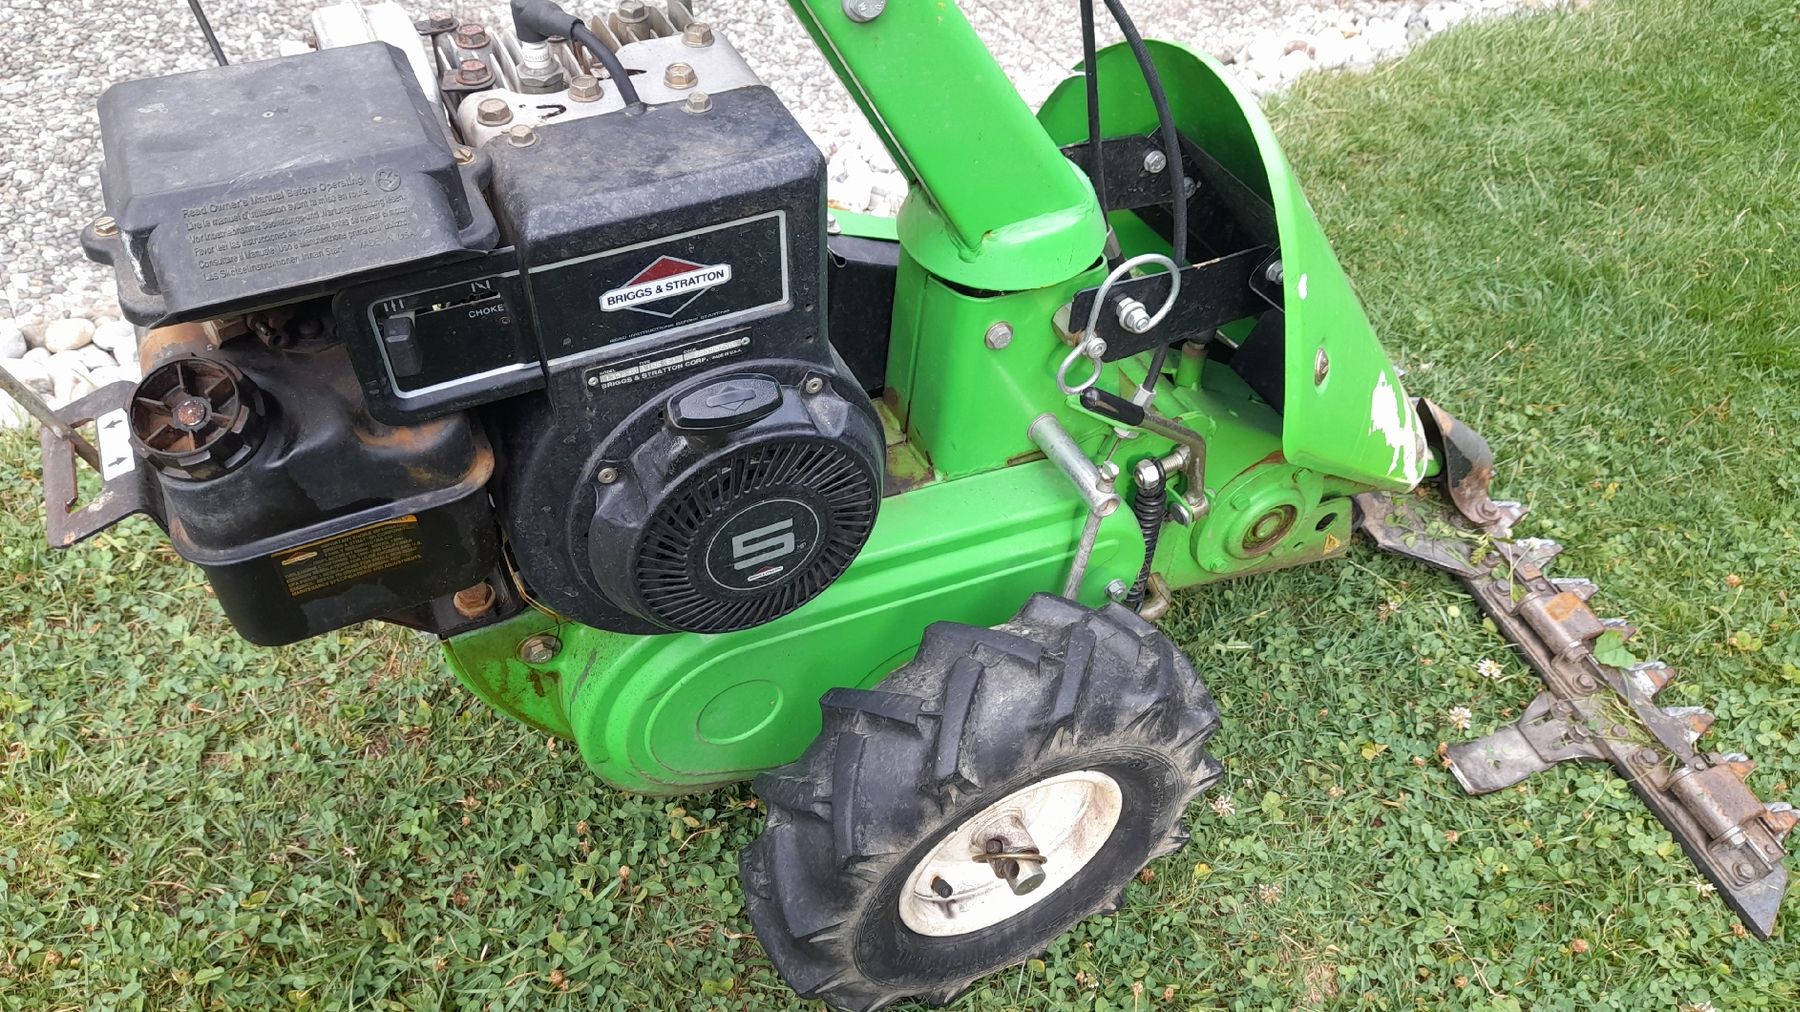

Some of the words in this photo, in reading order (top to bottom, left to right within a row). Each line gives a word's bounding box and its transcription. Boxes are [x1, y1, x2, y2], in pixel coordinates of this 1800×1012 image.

[182, 205, 208, 219] Read
[209, 198, 247, 212] Owner's
[250, 190, 284, 204] Manual
[286, 184, 317, 198] Before
[186, 220, 202, 231] Lire
[202, 218, 210, 227] le
[211, 212, 241, 226] manuel
[194, 244, 214, 256] Favor
[229, 239, 240, 249] las
[198, 252, 238, 269] Consultare
[607, 287, 652, 306] BRIGGS
[655, 285, 664, 294] &
[665, 269, 724, 291] STRATTON
[468, 304, 505, 318] CHOKE
[600, 376, 632, 389] BRIGGS
[640, 362, 683, 379] STRATTON
[683, 355, 709, 367] CORP.
[732, 518, 795, 570] 5
